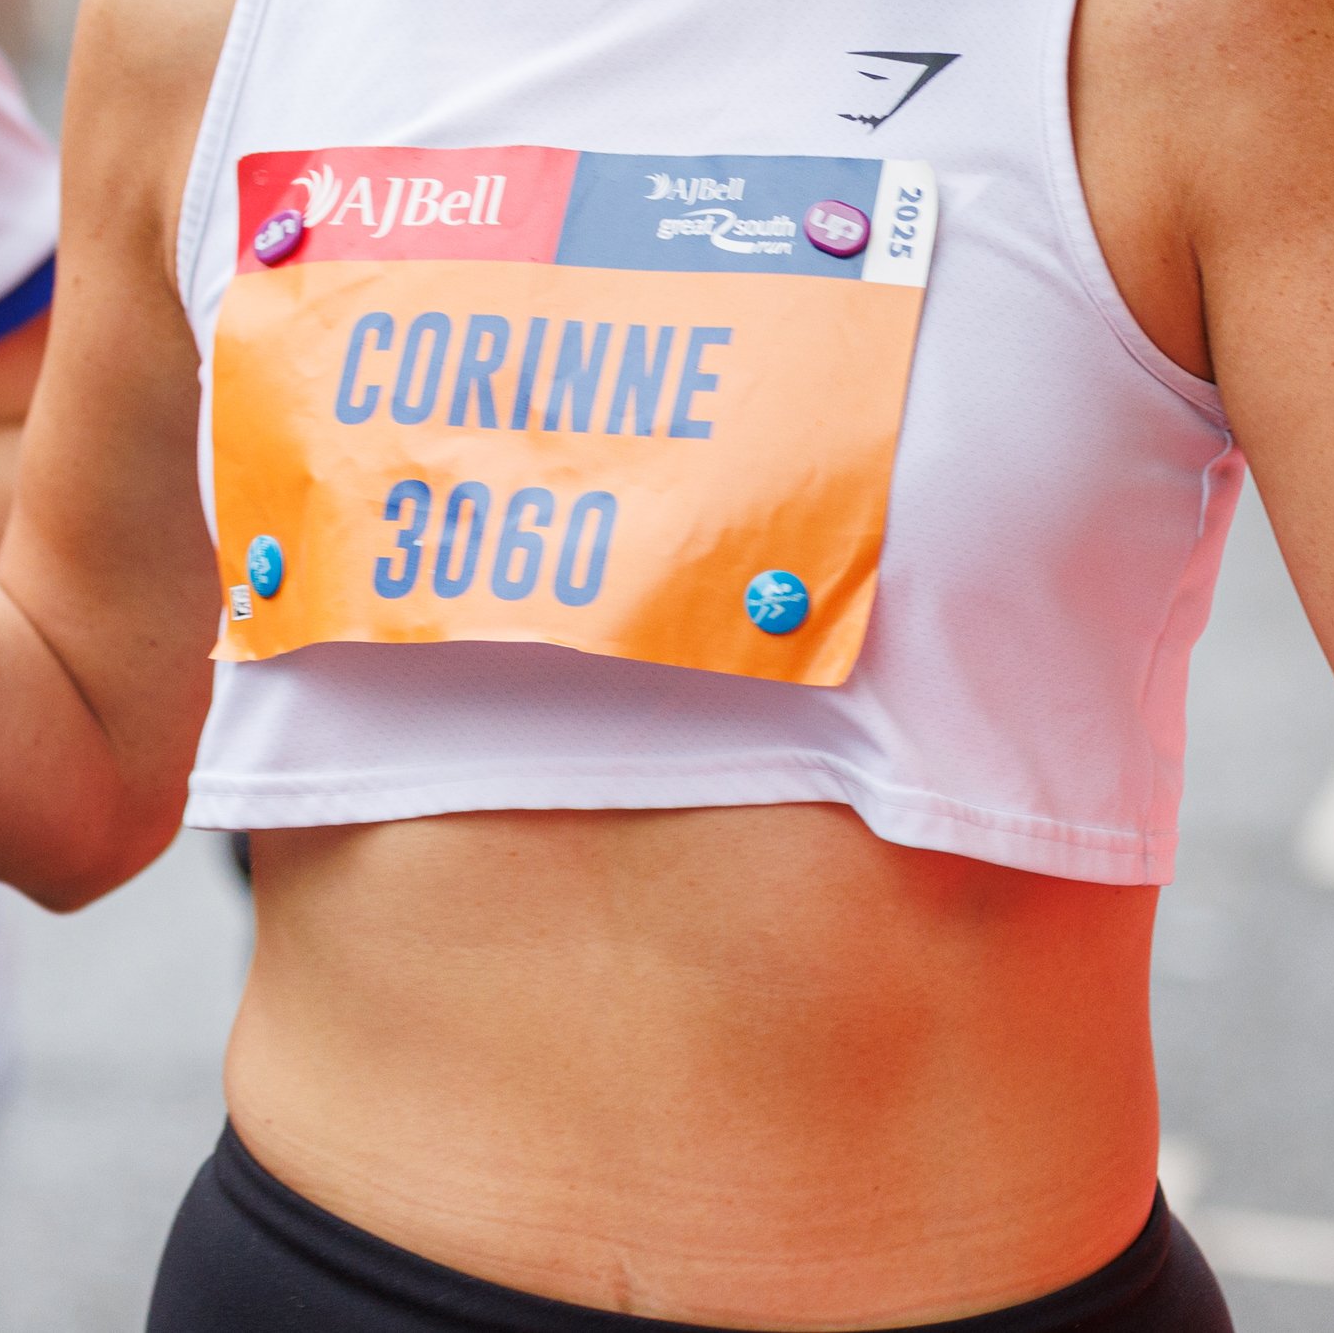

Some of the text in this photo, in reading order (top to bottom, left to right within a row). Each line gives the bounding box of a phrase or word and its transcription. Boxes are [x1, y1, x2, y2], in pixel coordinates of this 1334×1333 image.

[328, 174, 508, 239] AJBell
[655, 213, 798, 240] great south
[888, 185, 924, 260] 2025
[753, 240, 795, 256] run
[334, 310, 734, 441] CORINNE
[373, 478, 618, 607] 3060
